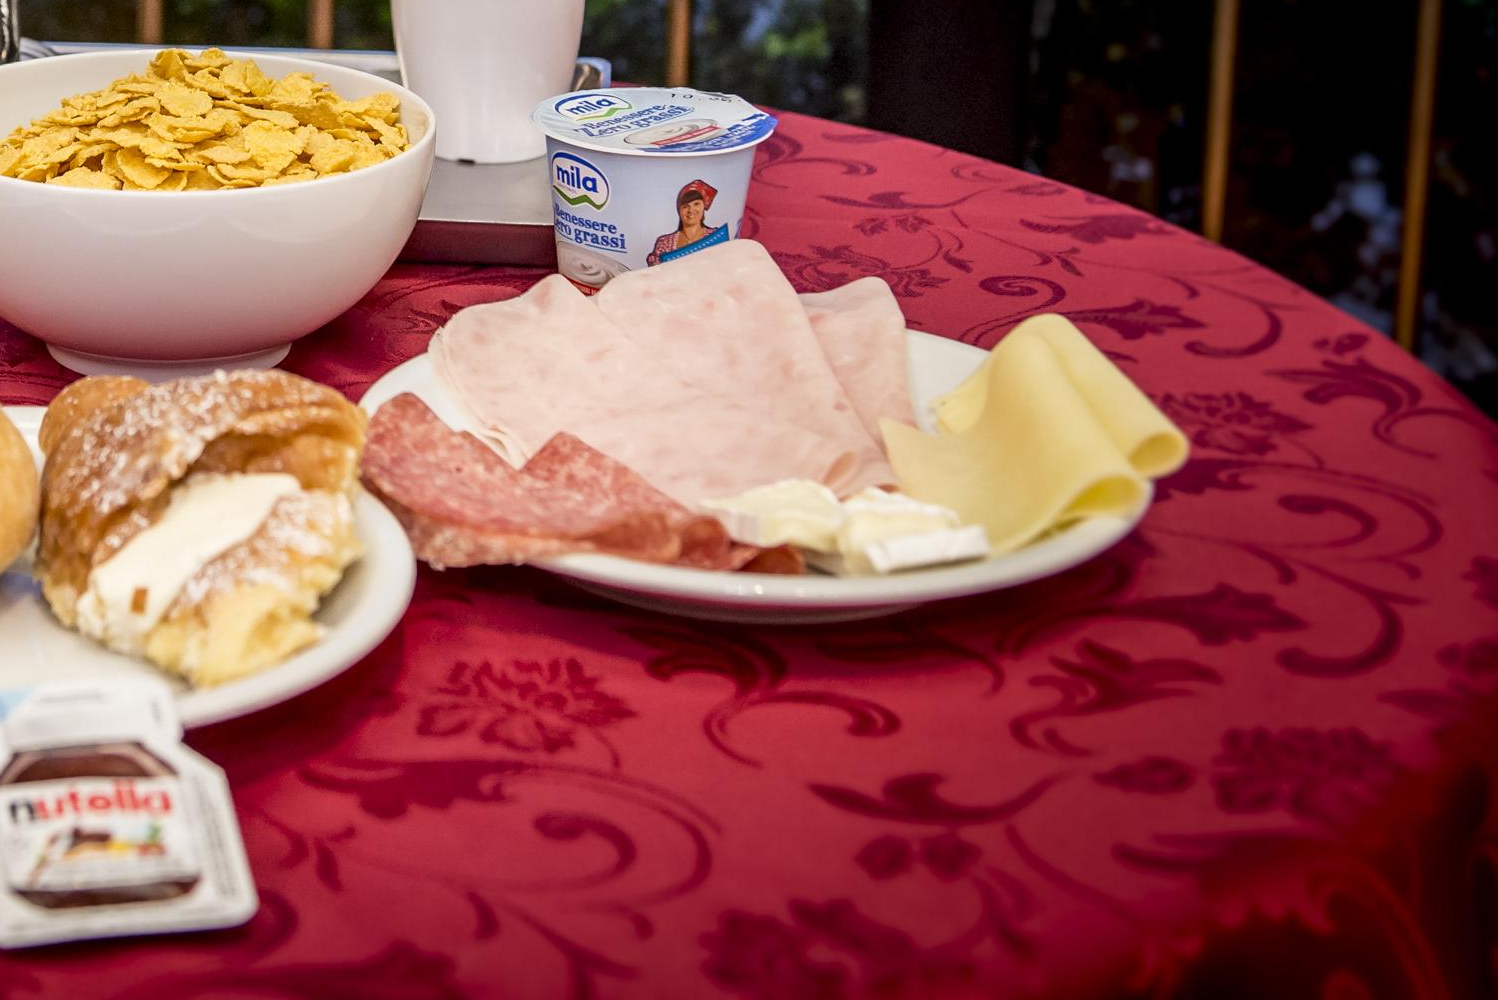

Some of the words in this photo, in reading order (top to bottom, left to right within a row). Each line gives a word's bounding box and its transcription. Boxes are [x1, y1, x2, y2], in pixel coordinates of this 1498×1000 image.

[565, 98, 618, 116] mila
[581, 104, 667, 130] Benessere
[631, 104, 692, 129] grassi
[556, 164, 599, 193] mila
[574, 228, 627, 249] grassi
[8, 779, 173, 824] nutella
